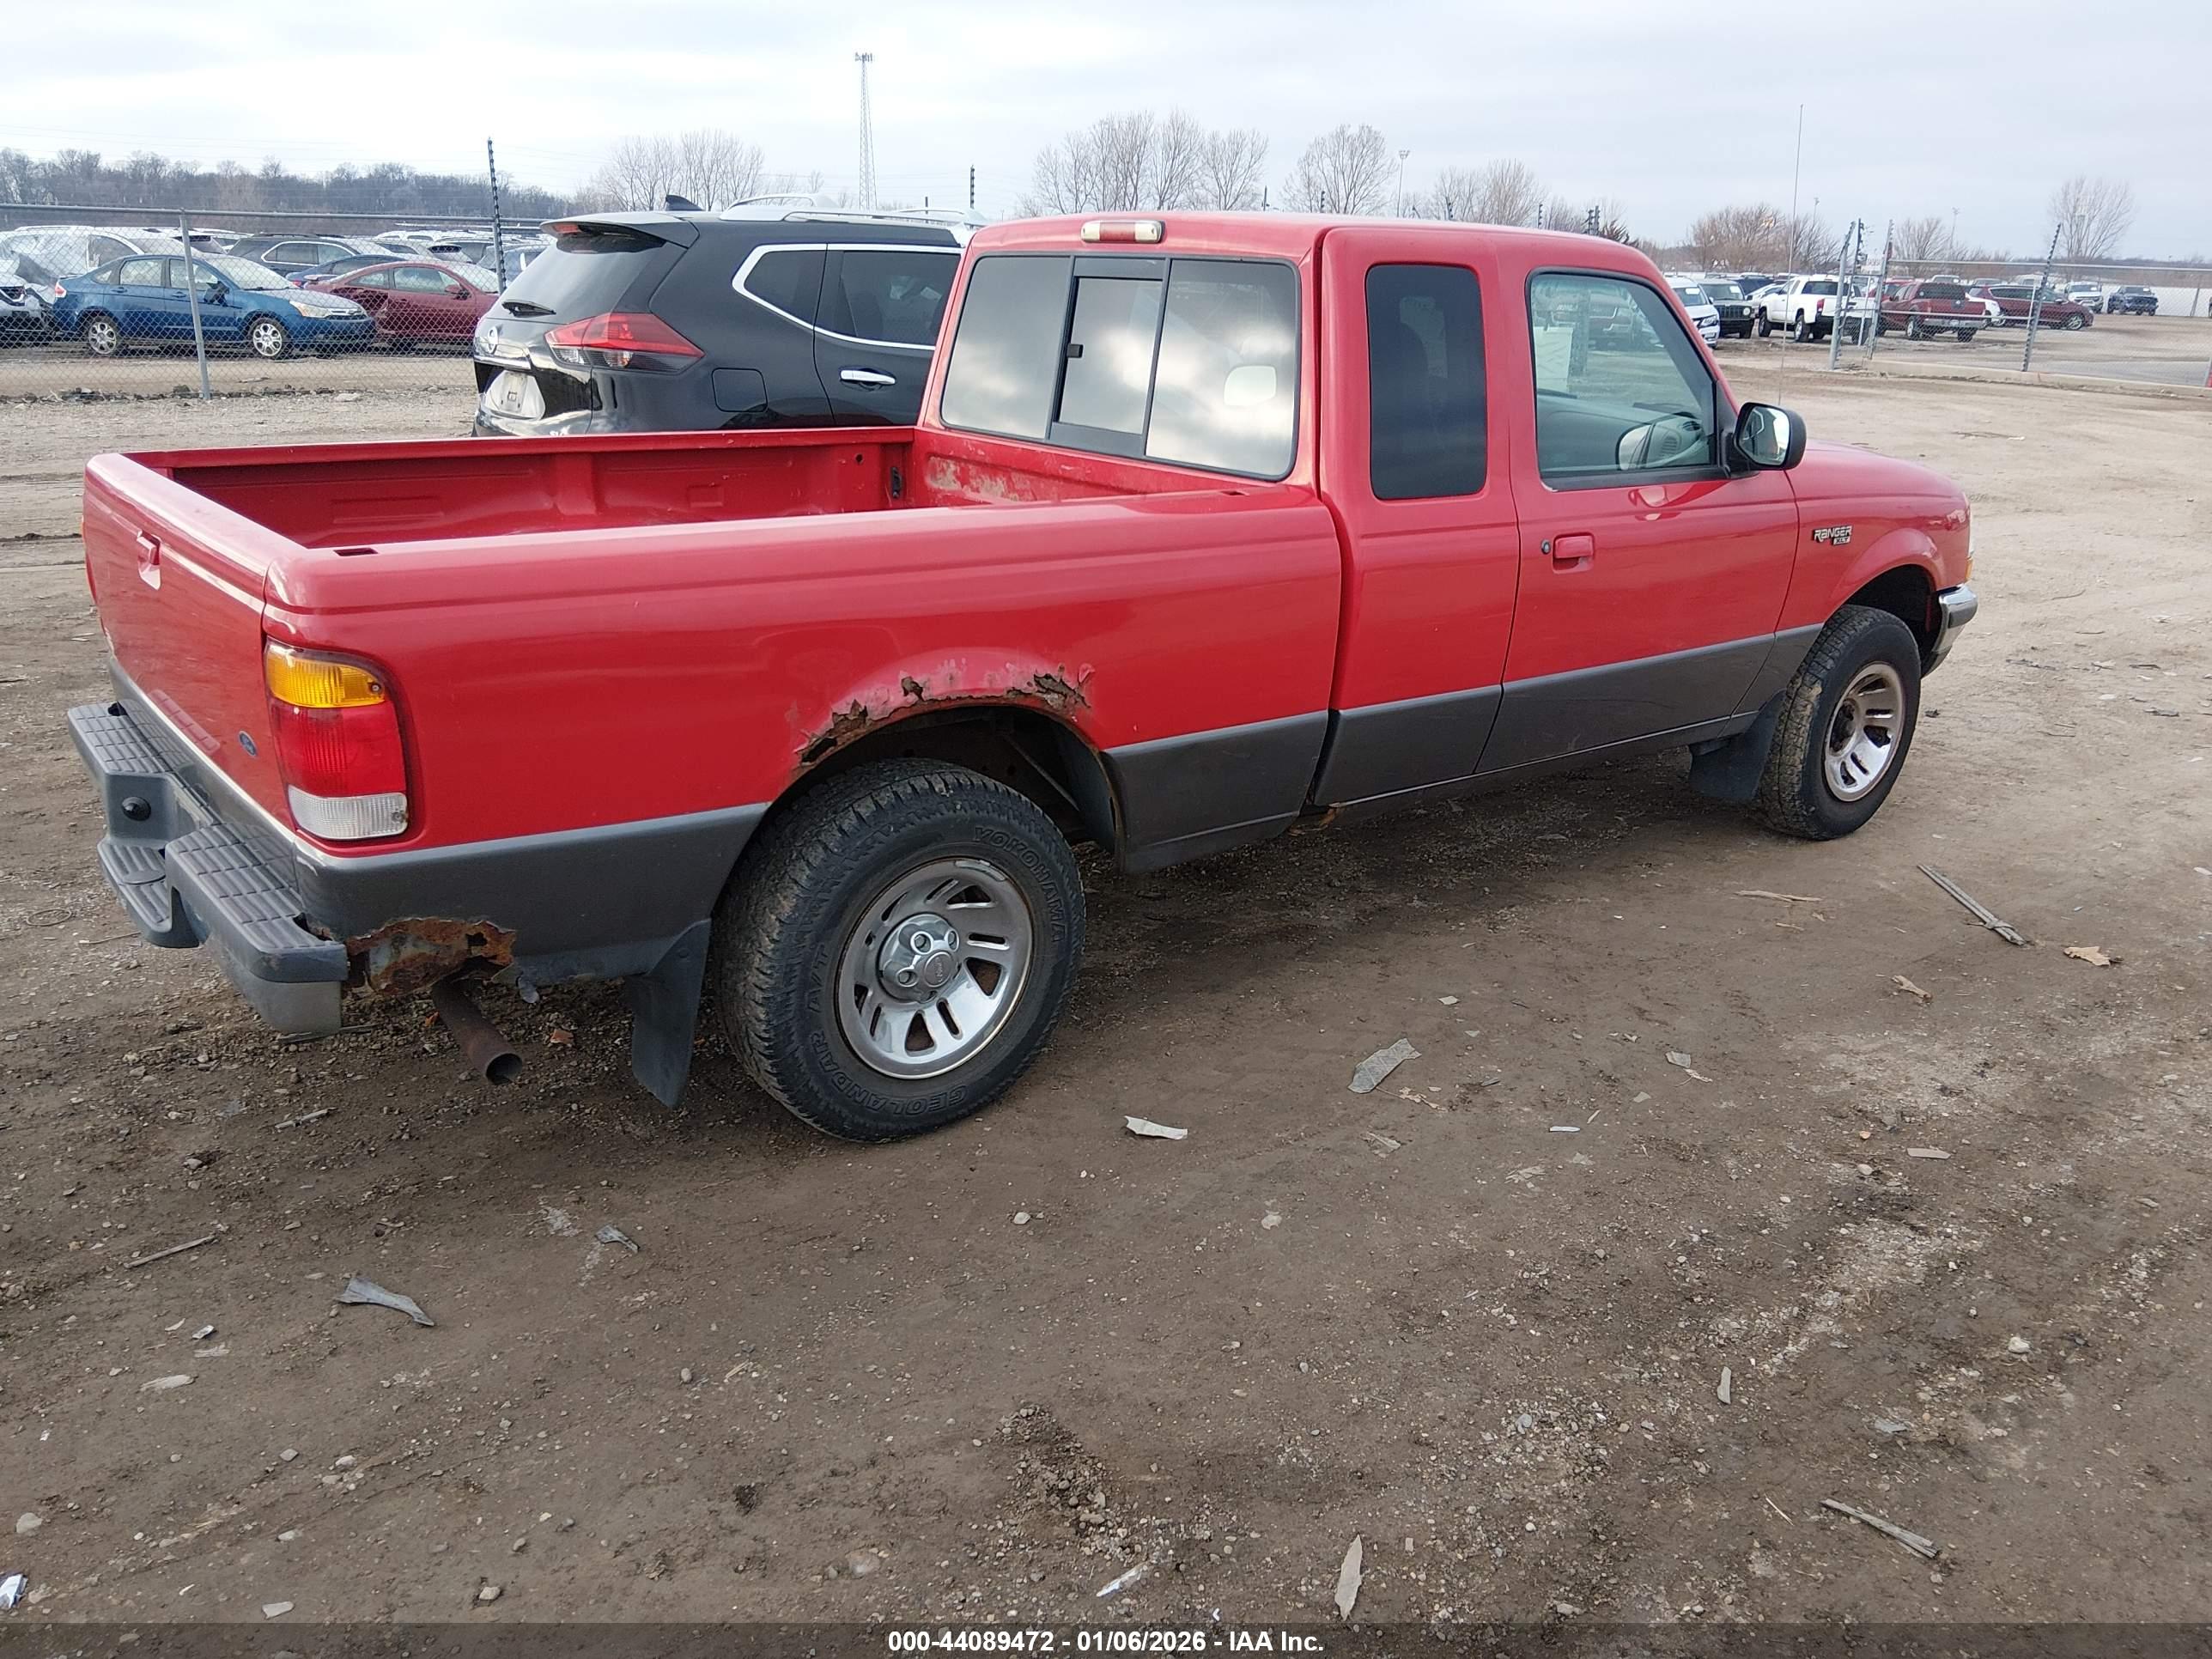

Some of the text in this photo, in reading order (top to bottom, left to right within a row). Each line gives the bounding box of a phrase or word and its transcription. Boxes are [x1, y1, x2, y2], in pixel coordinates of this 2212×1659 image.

[1813, 526, 1852, 543] RANGER
[973, 827, 1066, 943] YOKOHAMA
[811, 1032, 967, 1115] GEOLANDAR
